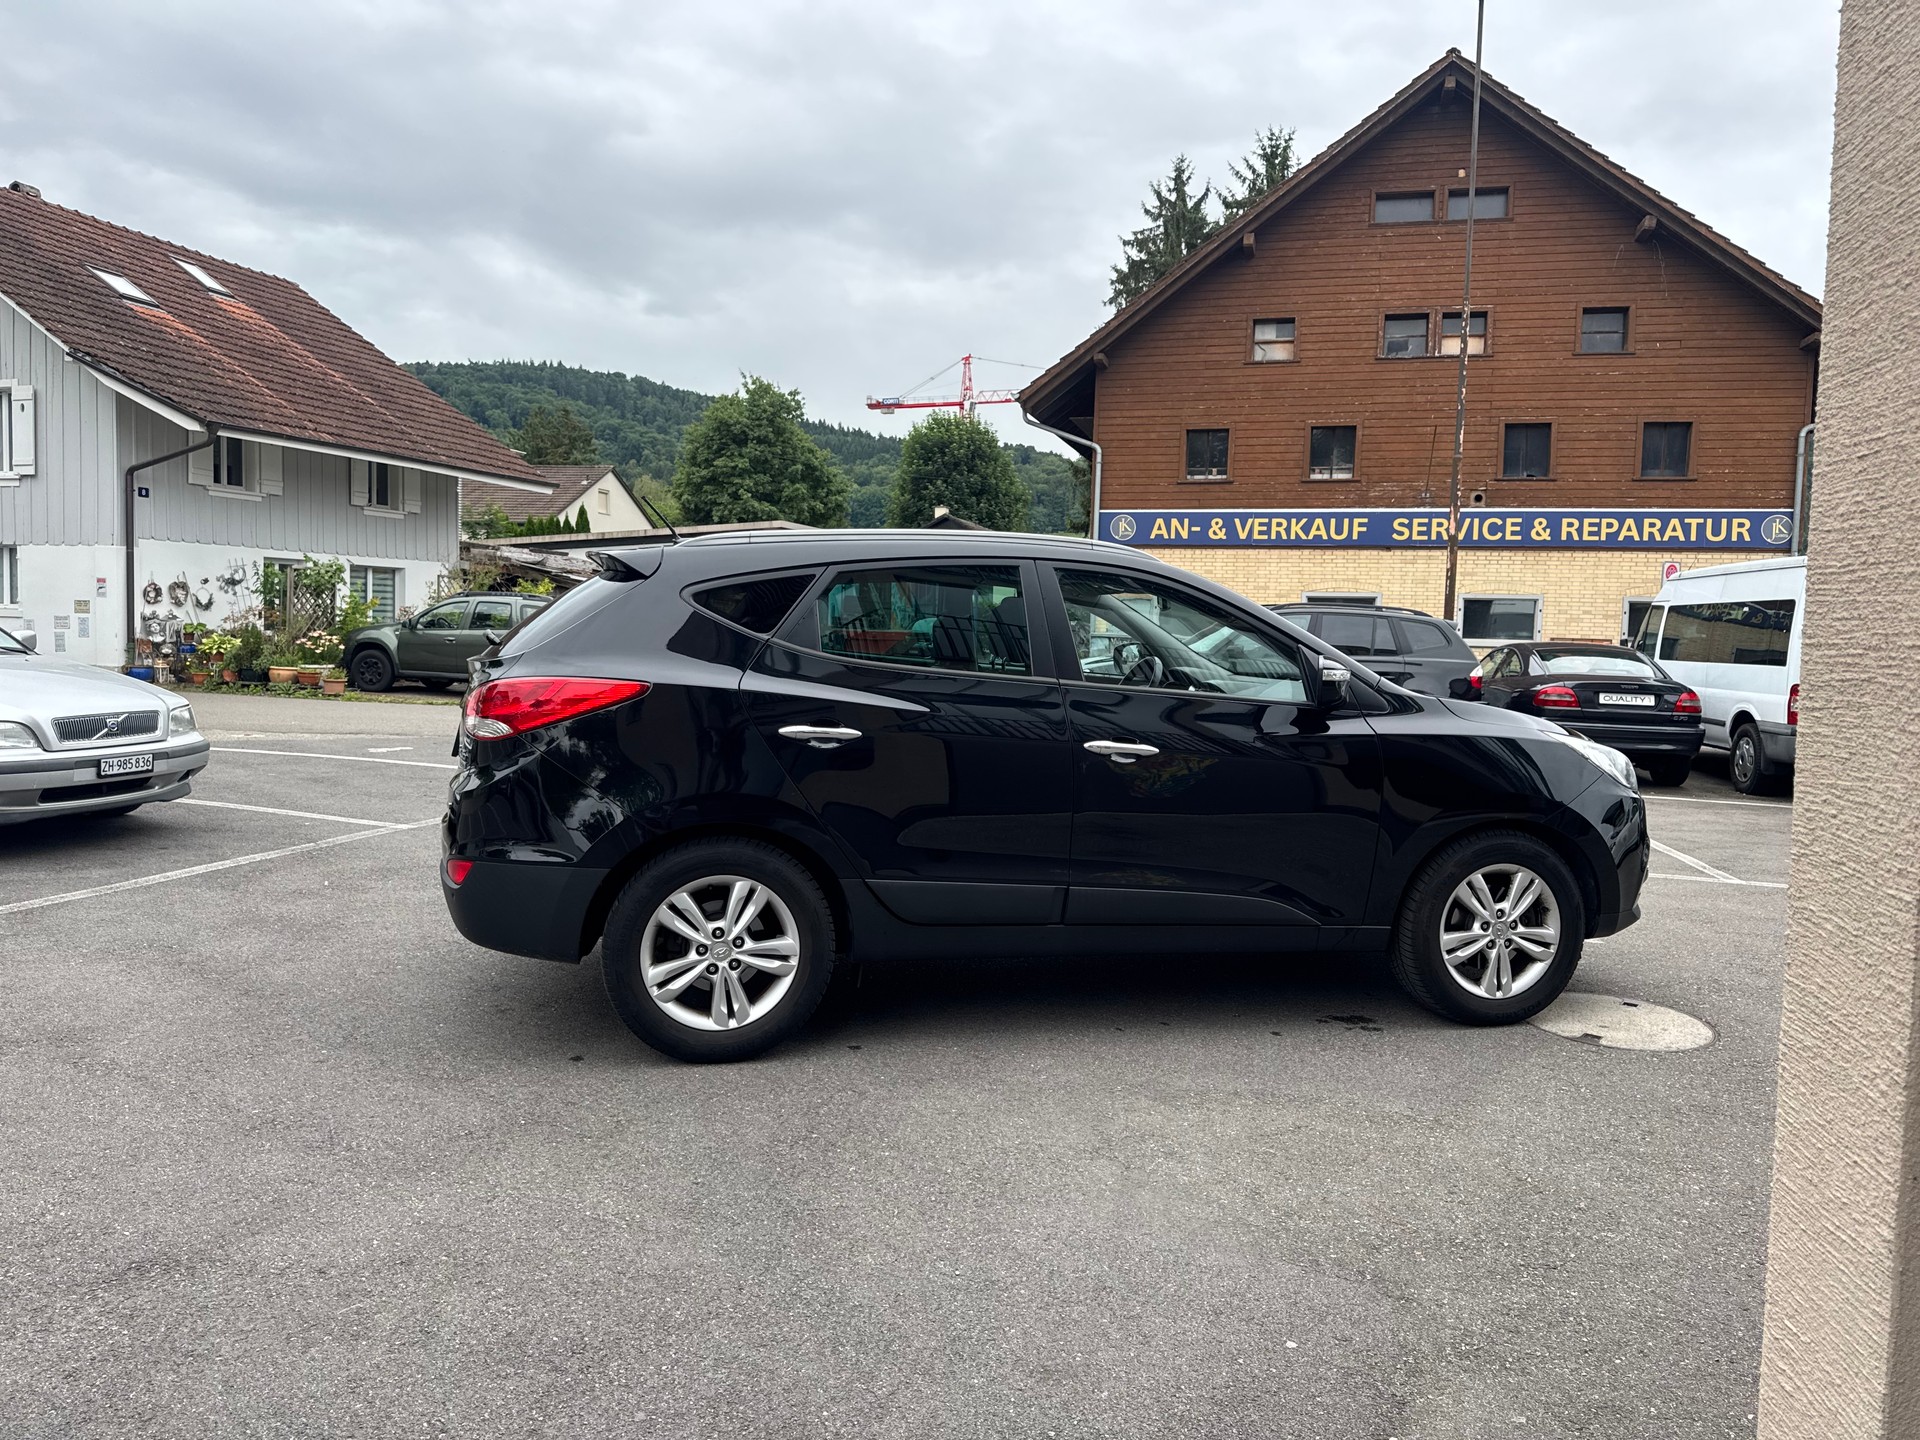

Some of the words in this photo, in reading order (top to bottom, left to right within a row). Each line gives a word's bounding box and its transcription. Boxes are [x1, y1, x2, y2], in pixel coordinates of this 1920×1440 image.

[1150, 517, 1201, 540] AN-
[1208, 517, 1227, 540] &
[1234, 517, 1369, 541] VERKAUF
[1391, 517, 1523, 541] SERVICE
[1530, 517, 1552, 541] &
[1560, 517, 1752, 542] REPARATUR
[1603, 695, 1646, 703] QUALITY
